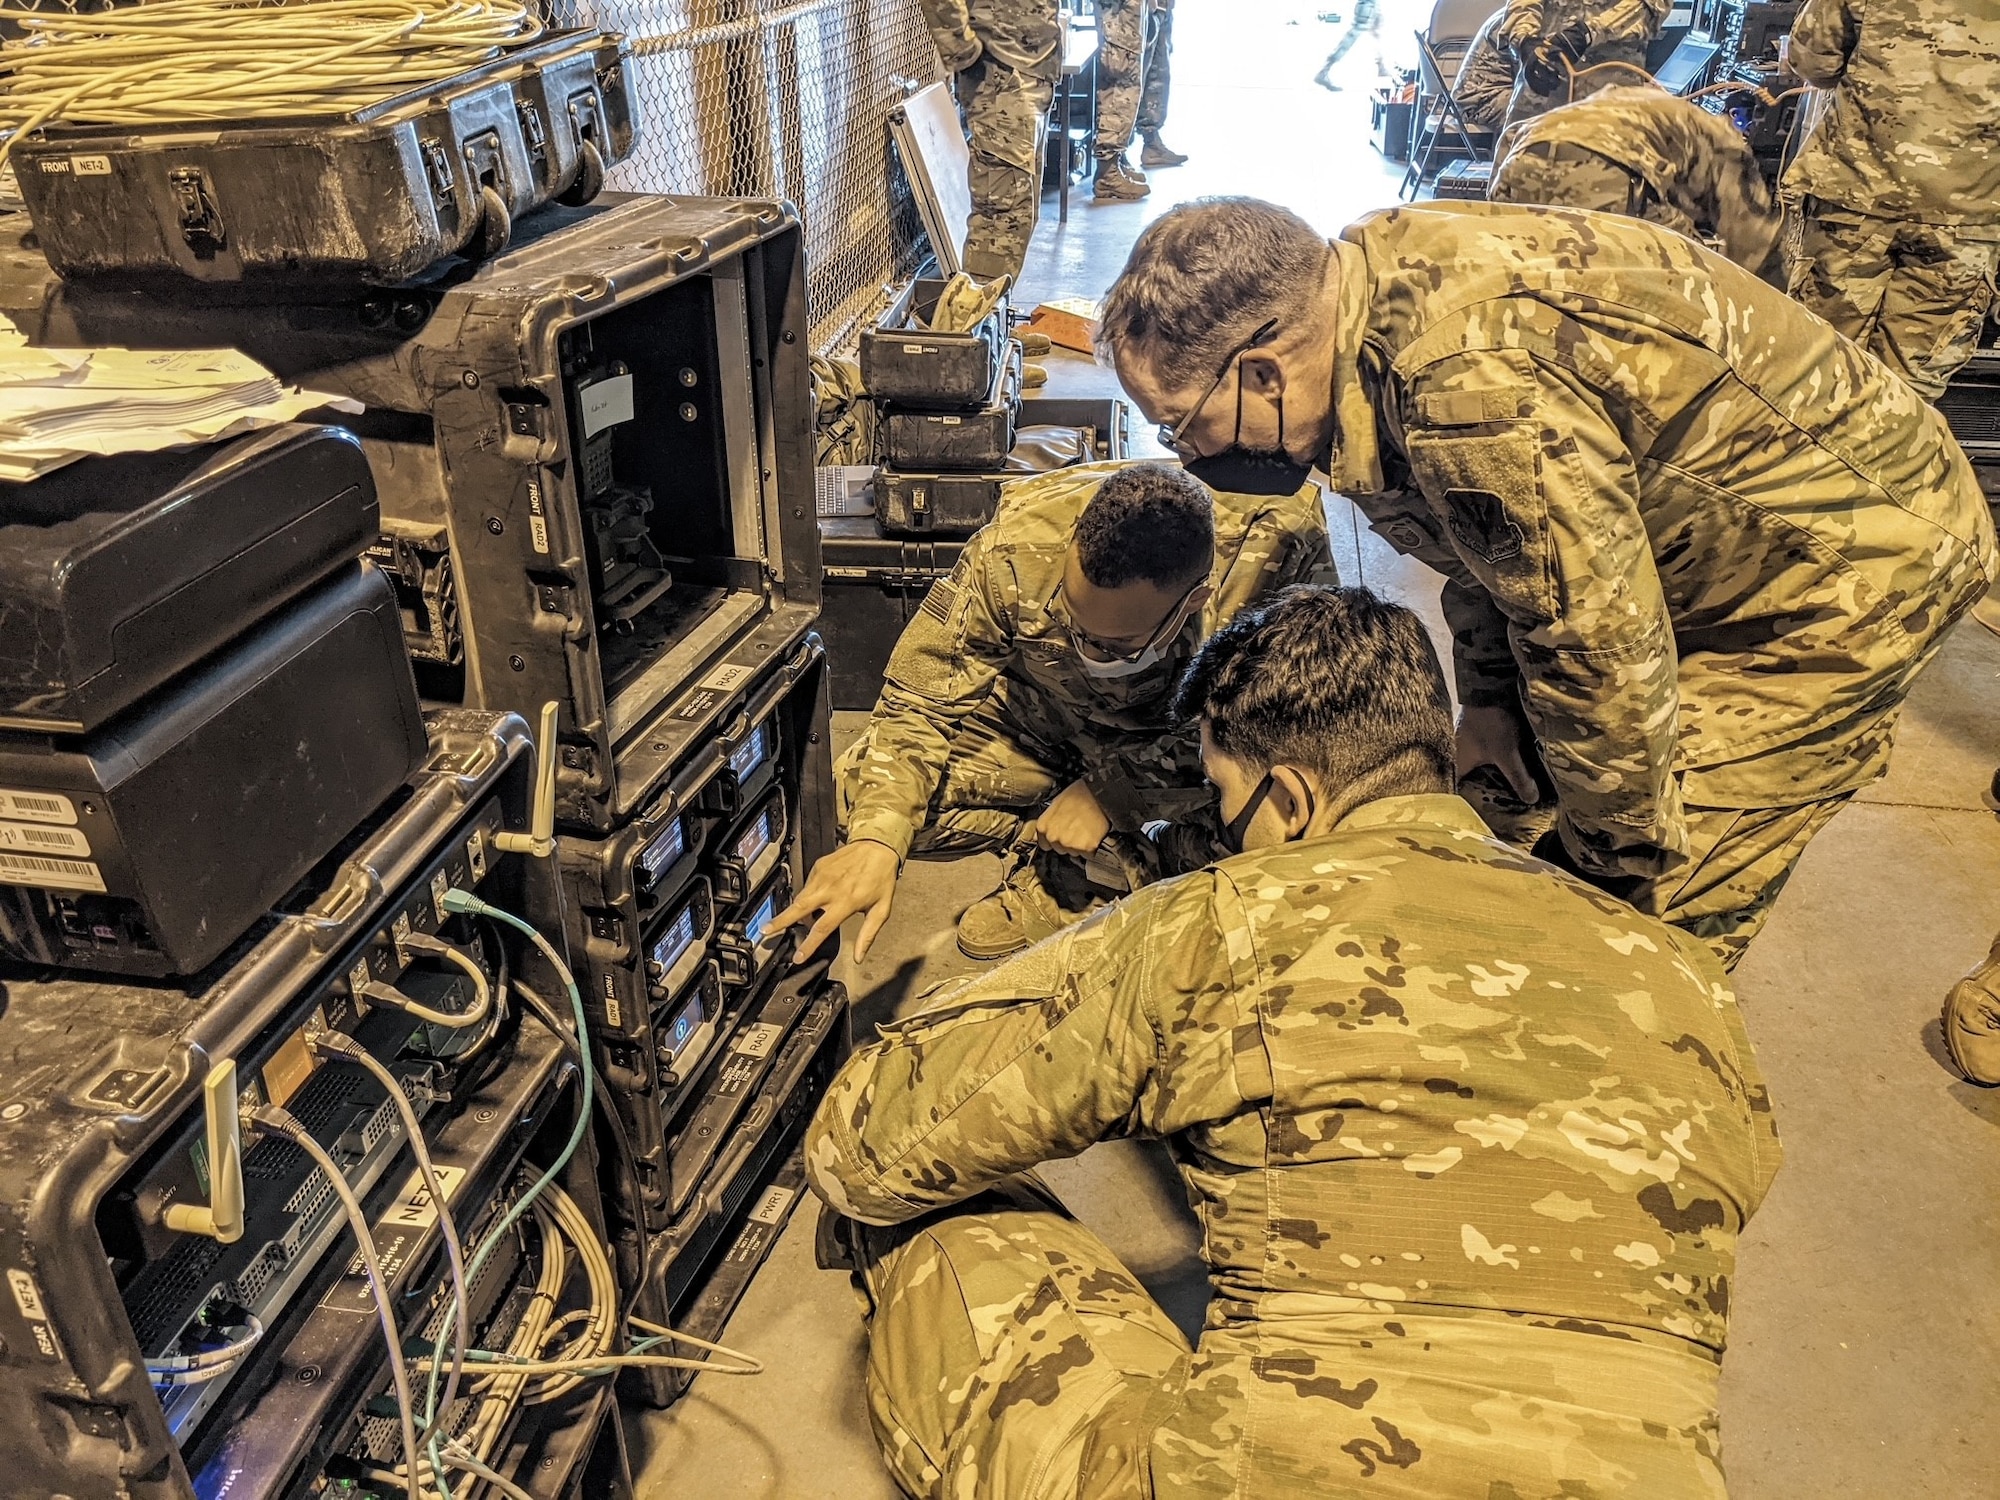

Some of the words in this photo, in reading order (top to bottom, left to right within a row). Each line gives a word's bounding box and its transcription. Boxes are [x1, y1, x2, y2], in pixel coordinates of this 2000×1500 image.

[41, 161, 70, 173] FRONT
[80, 160, 104, 171] NET-2
[528, 483, 541, 515] FRONT
[534, 522, 545, 547] RAD2
[716, 668, 742, 687] RAD2
[604, 975, 614, 998] FRONT
[608, 1003, 617, 1020] RAD1
[750, 1029, 772, 1052] RAD1
[399, 1170, 450, 1221] NET2
[760, 1192, 784, 1219] PWR1
[384, 1258, 402, 1276] T134
[16, 1280, 36, 1310] NET-2
[32, 1325, 55, 1356] REAR
